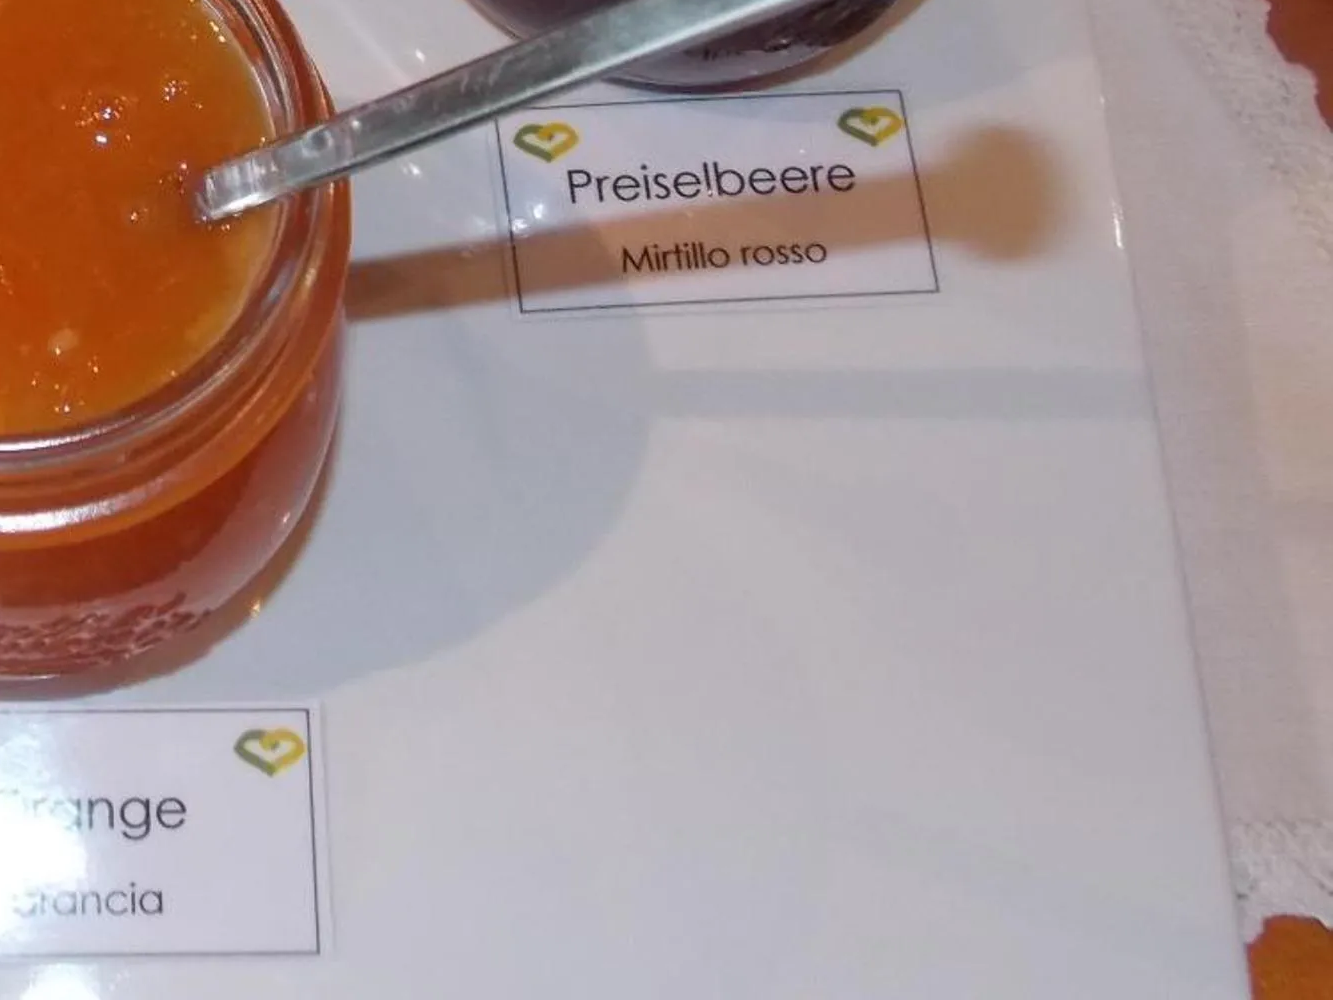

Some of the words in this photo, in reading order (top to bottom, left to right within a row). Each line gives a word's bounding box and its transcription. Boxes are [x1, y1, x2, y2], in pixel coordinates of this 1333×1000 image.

[567, 162, 856, 205] Preiselbeere
[621, 242, 731, 274] Mirtillo
[740, 240, 828, 267] rosso
